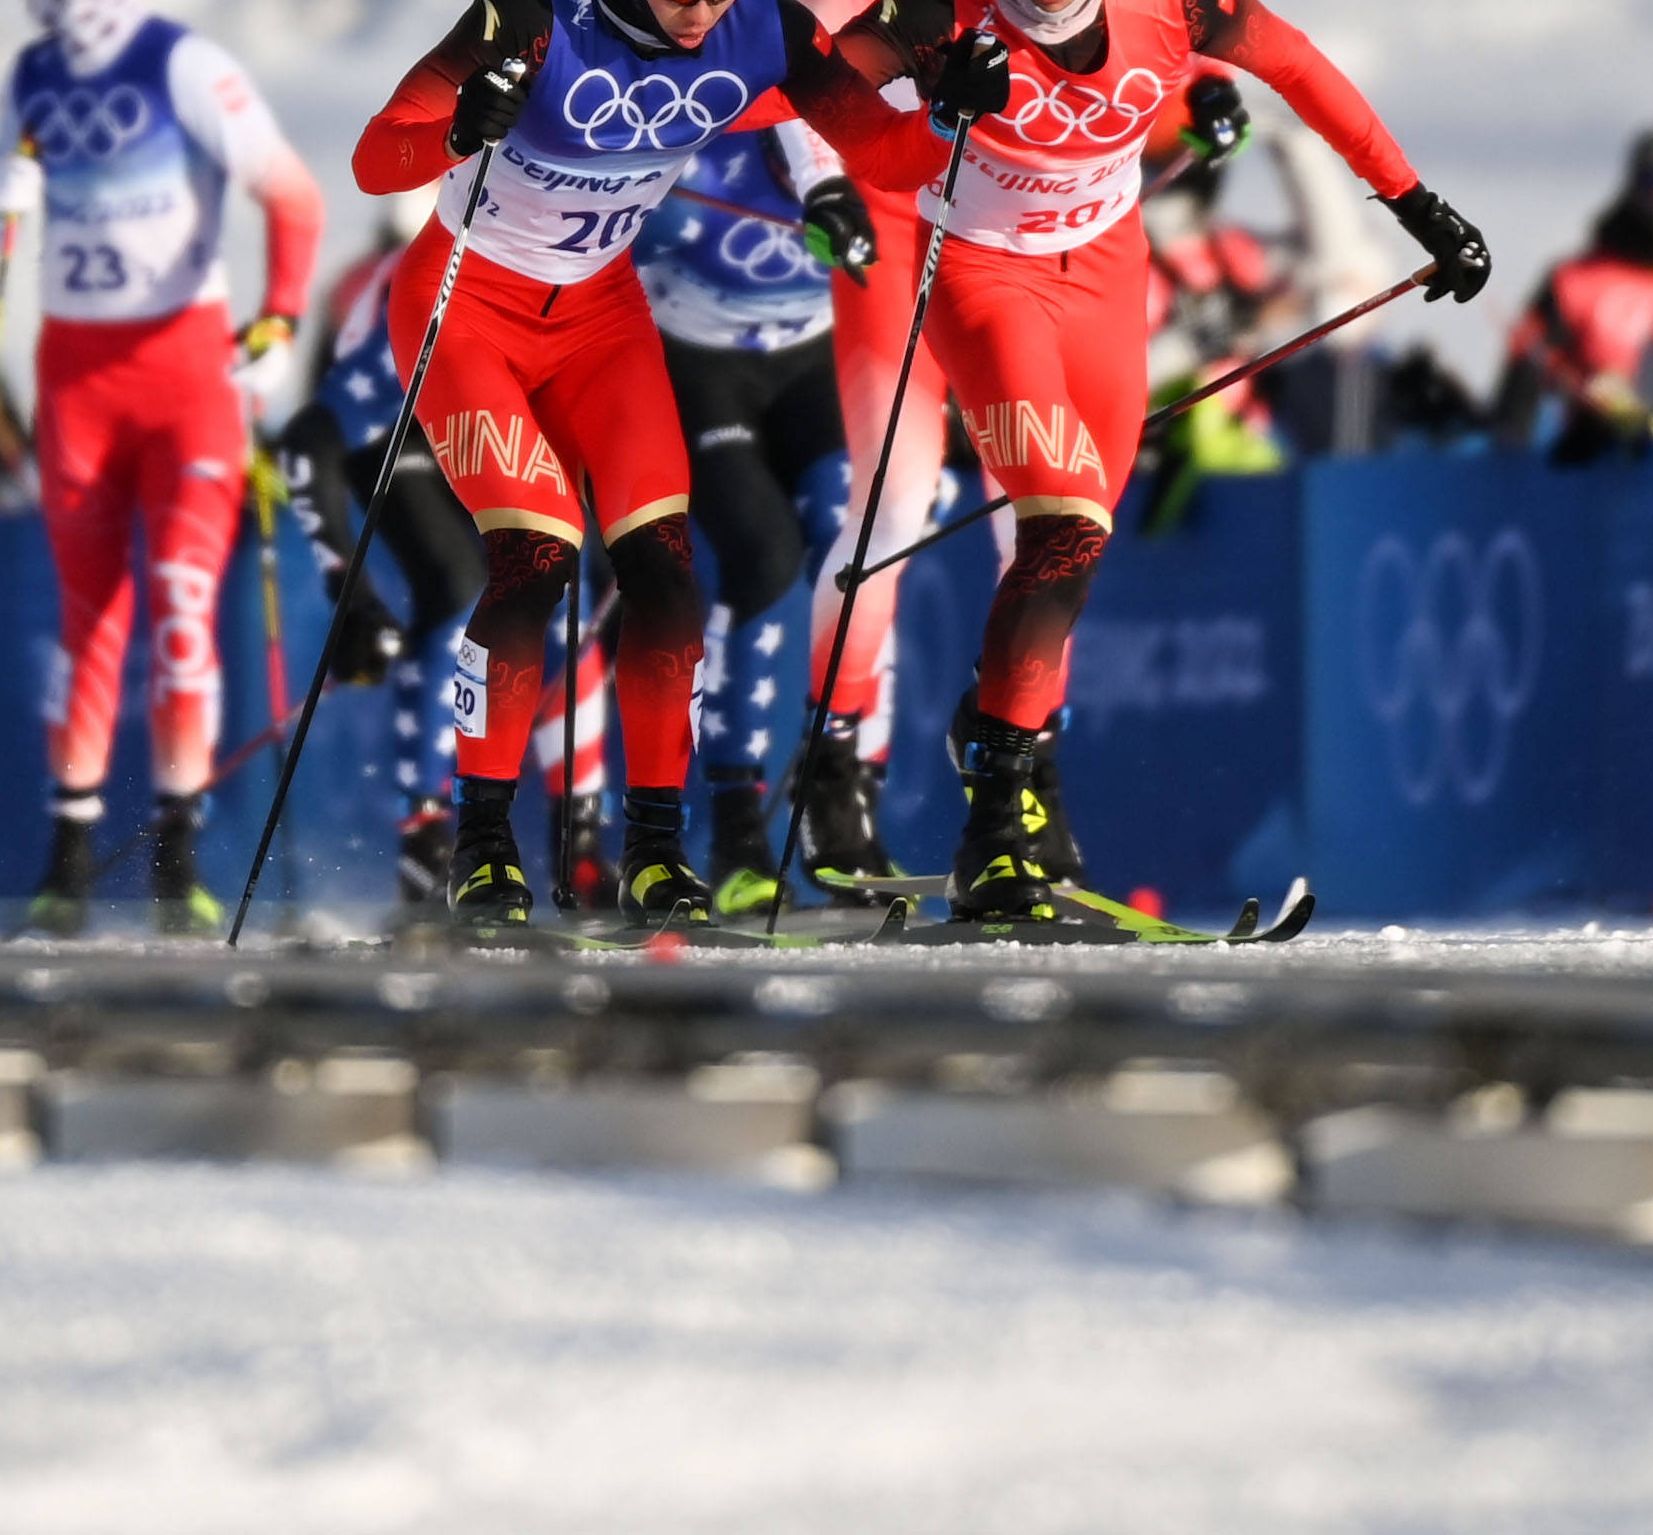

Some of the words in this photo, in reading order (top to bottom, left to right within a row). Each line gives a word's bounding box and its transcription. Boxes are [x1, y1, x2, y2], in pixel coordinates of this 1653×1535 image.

[502, 147, 632, 195] BEIJING
[59, 243, 129, 292] 23
[425, 409, 569, 497] HINA
[961, 399, 1108, 490] HINA
[454, 680, 476, 716] 20
